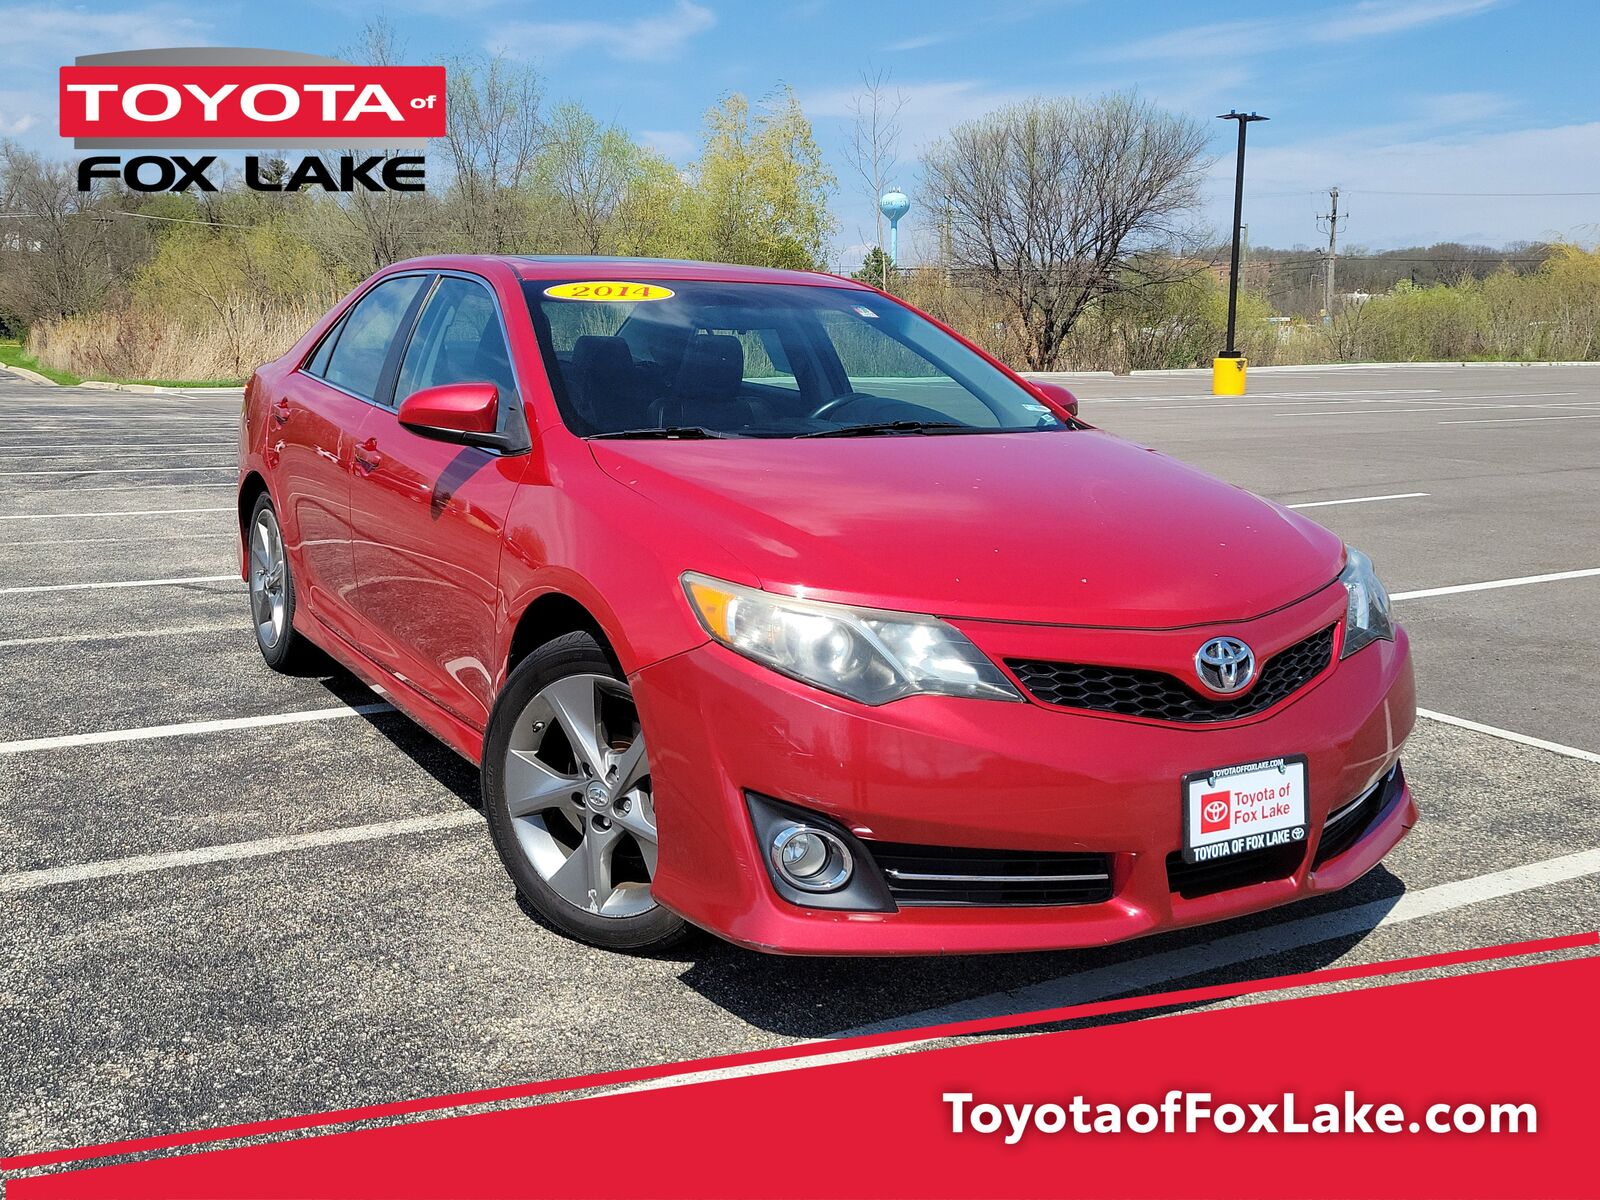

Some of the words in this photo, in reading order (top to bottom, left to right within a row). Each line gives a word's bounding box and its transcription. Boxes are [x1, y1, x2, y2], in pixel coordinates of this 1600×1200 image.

[571, 286, 653, 297] 2014
[1234, 788, 1275, 808] Toyota
[1279, 782, 1291, 798] of
[1235, 810, 1257, 824] Fox
[1261, 802, 1290, 819] Lake
[1193, 841, 1231, 862] TOYOTA
[1231, 838, 1245, 854] OF
[1246, 834, 1265, 850] FOX
[1266, 829, 1290, 846] LAKE
